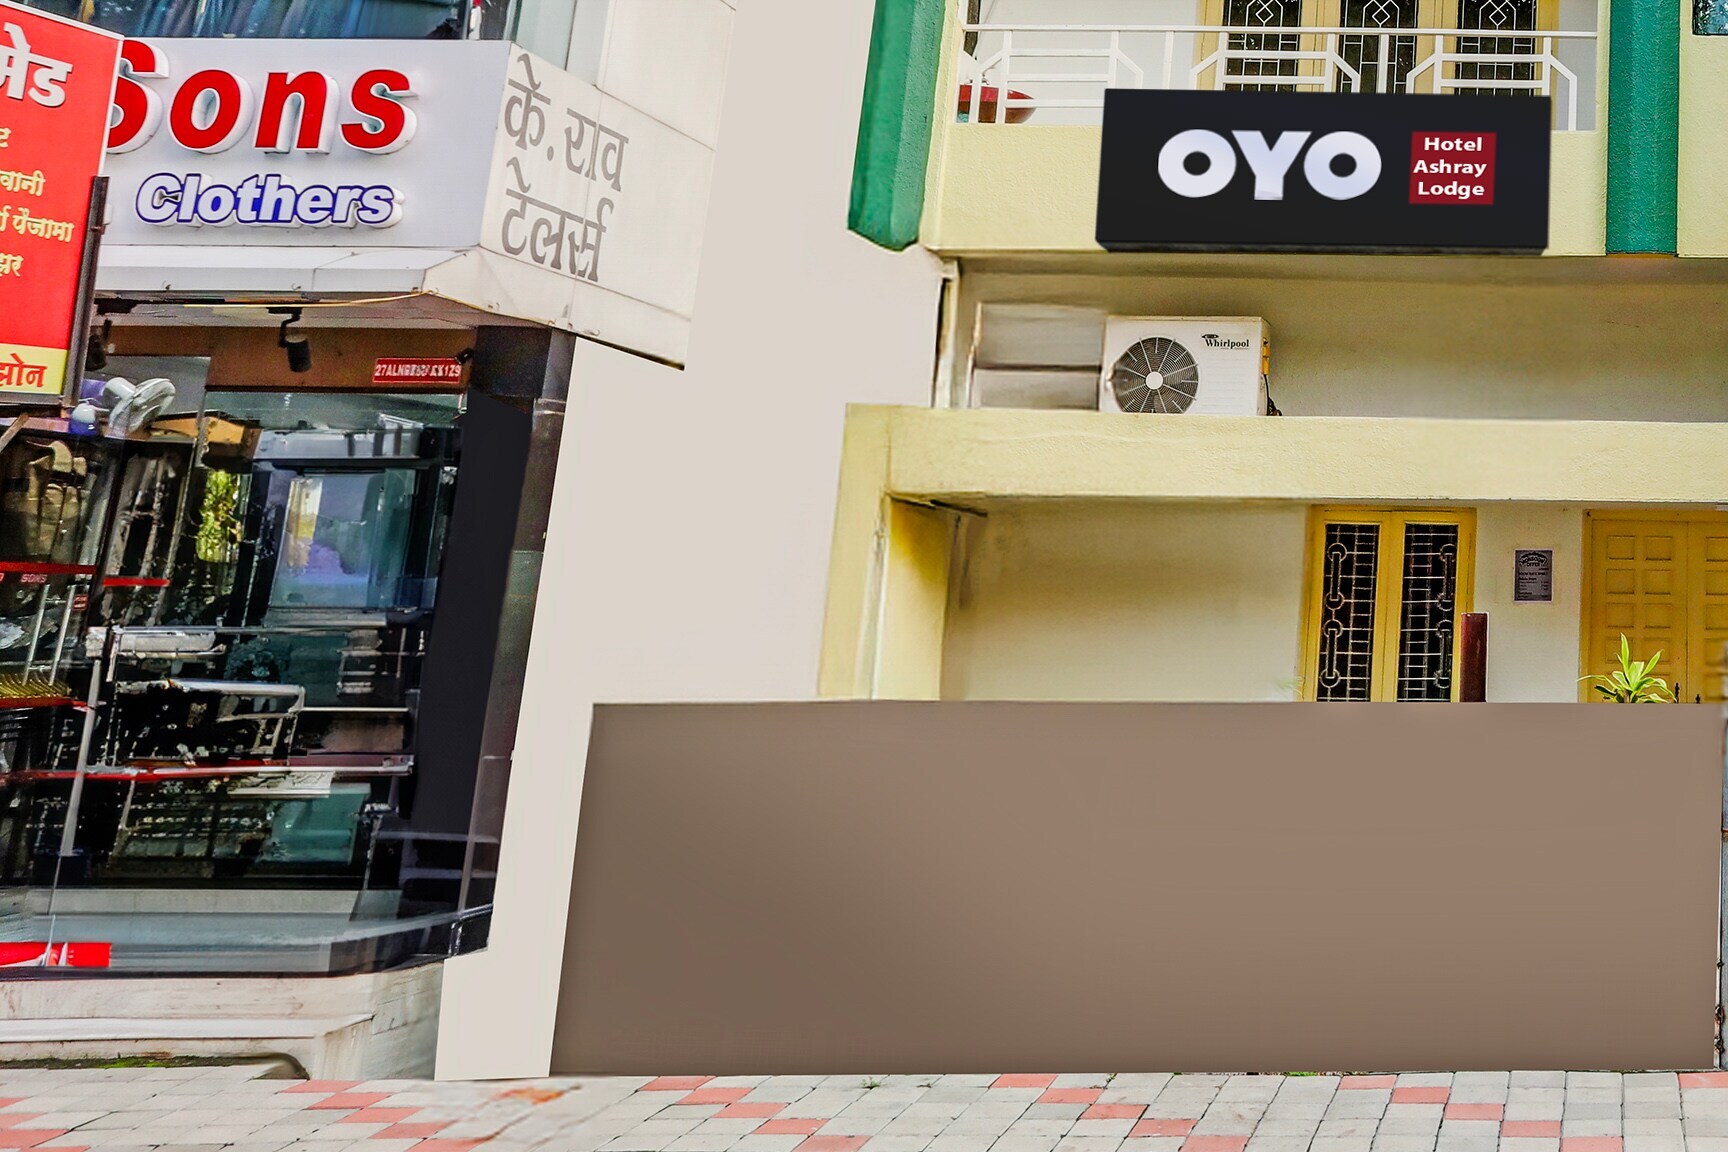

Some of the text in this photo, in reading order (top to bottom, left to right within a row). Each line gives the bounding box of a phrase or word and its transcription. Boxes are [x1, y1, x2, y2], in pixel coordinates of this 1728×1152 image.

[107, 39, 418, 154] Sons
[1424, 136, 1483, 152] Hotel
[1157, 128, 1382, 201] OYO
[1412, 158, 1488, 178] Ashray
[135, 172, 404, 227] Clothers
[1417, 180, 1486, 200] Lodge
[12, 207, 75, 243] पैजामा
[501, 156, 615, 282] टेलर्स
[1204, 338, 1250, 350] Whirlpool
